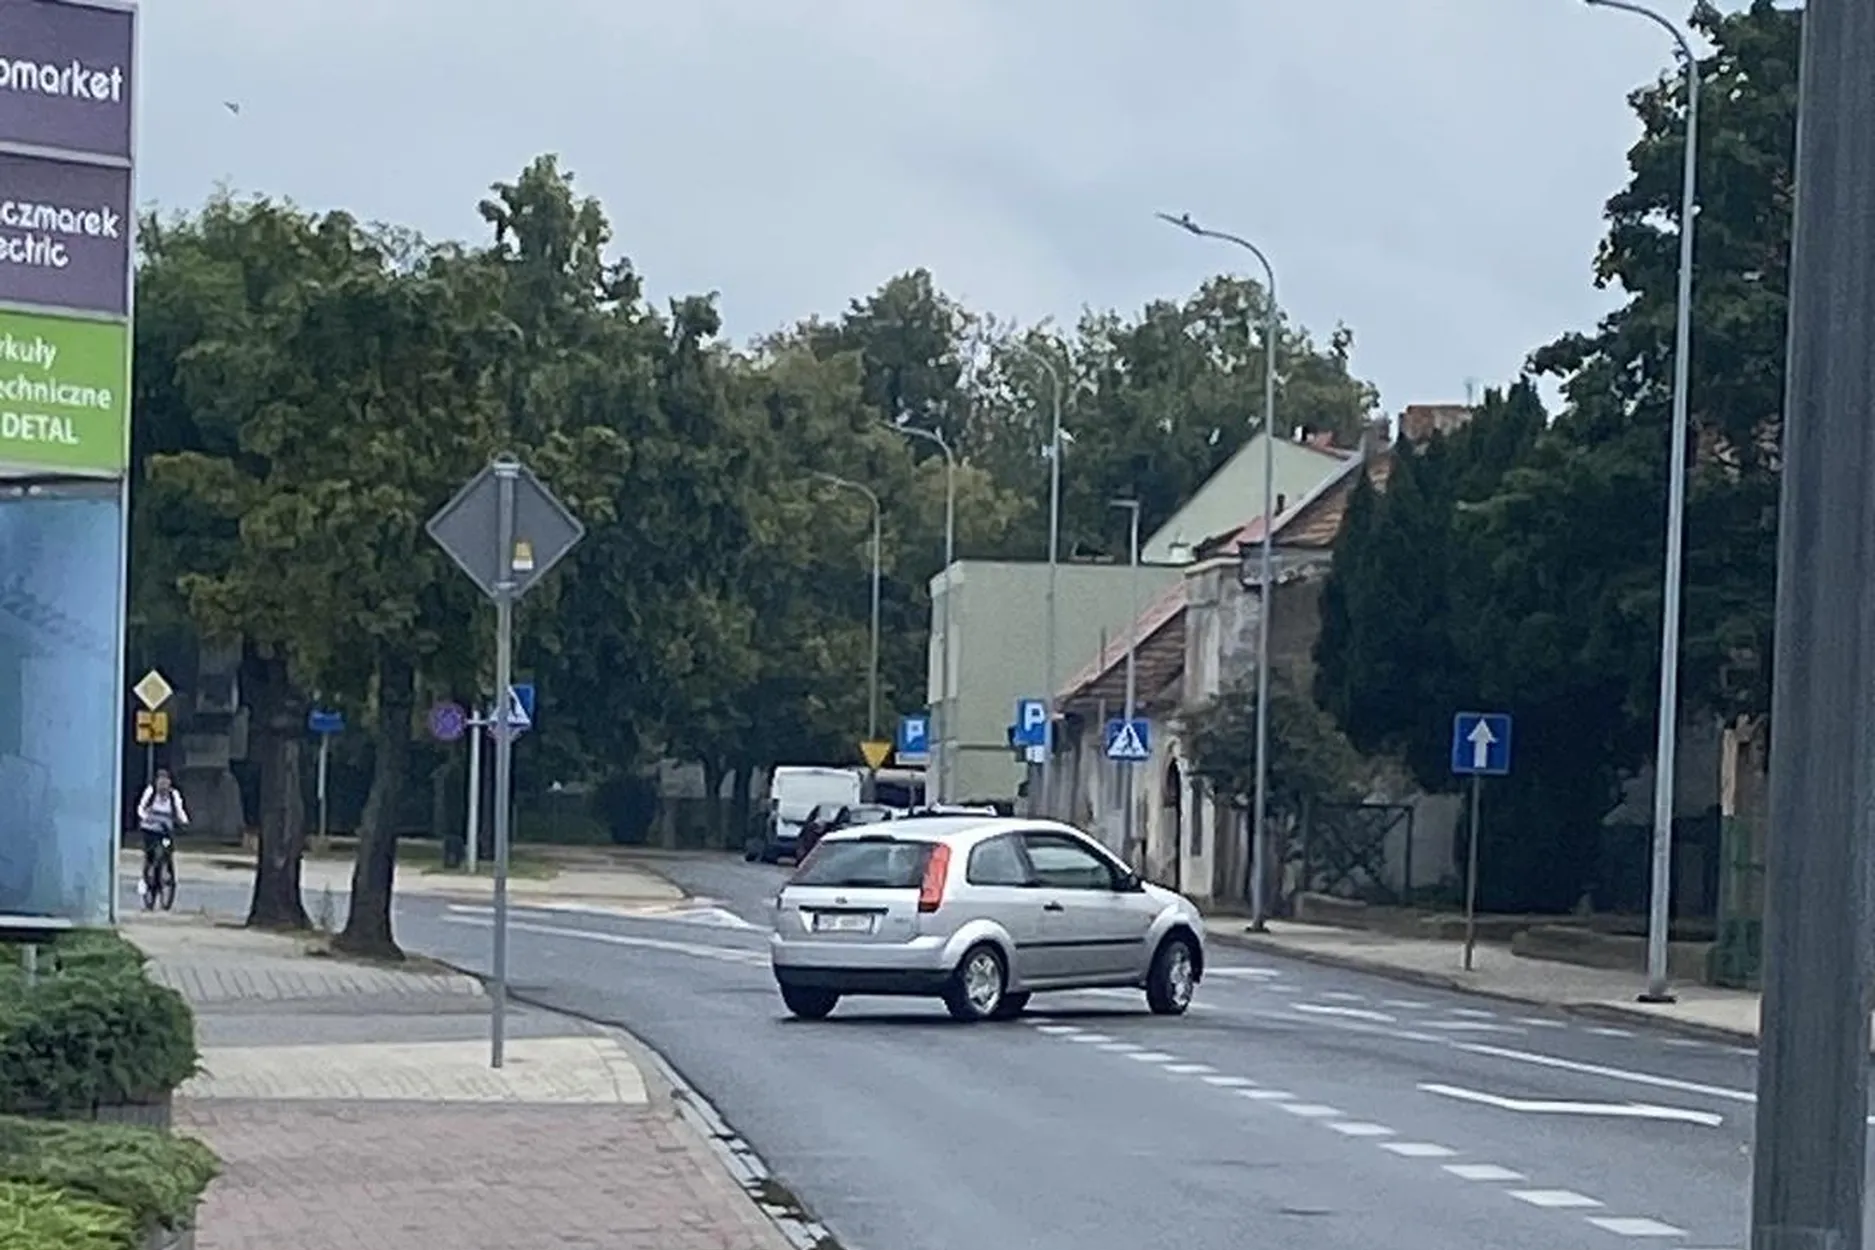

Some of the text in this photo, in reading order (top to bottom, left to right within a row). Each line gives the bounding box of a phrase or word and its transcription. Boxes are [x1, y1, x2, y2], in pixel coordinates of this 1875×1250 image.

[1, 200, 119, 238] czmarek
[1, 411, 80, 444] DETAL
[906, 719, 925, 744] P
[1024, 702, 1045, 732] P
